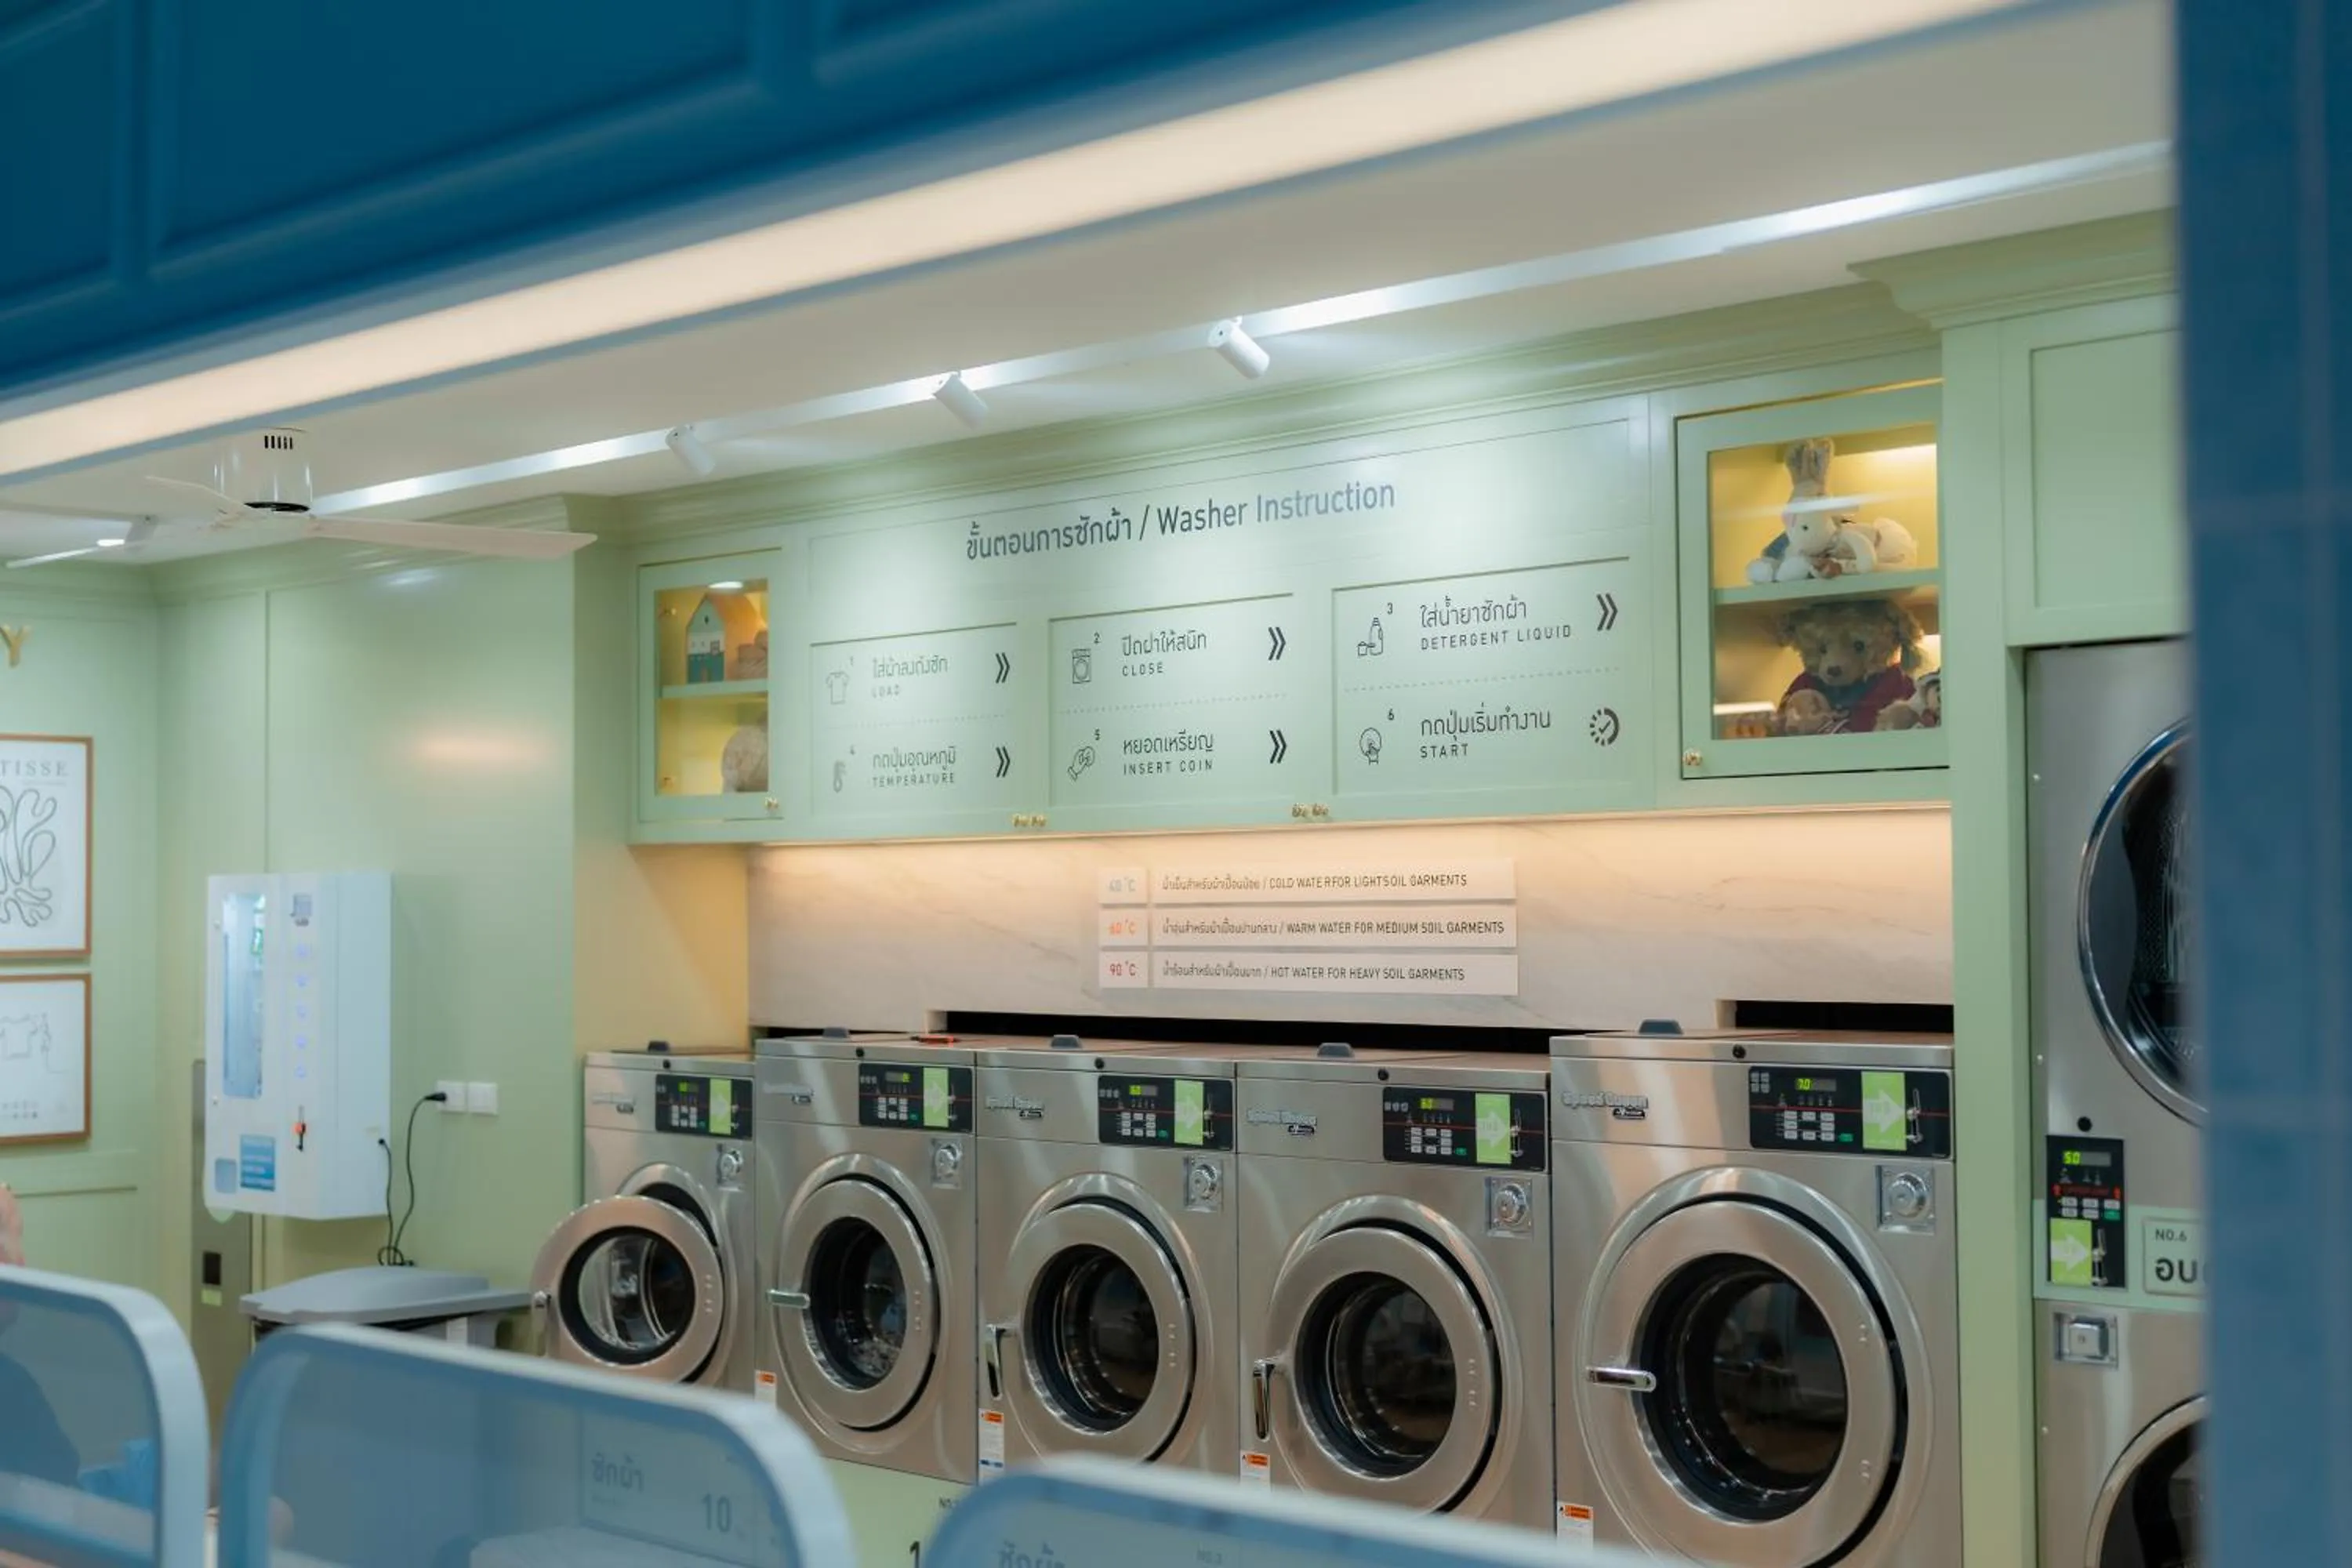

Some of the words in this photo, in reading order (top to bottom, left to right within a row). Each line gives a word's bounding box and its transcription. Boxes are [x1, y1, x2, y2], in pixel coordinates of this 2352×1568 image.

[967, 507, 1131, 560] ขั้นตอนการซักผ้า
[1139, 504, 1150, 541] /
[1157, 499, 1248, 535] Washer
[1256, 481, 1395, 523] Instruction
[1387, 602, 1393, 615] 3
[1420, 595, 1527, 628] ใส่น้ำยาซักผ้า
[1094, 632, 1100, 644] 2
[1121, 630, 1207, 657] ปิดฝาให้สนิท
[1421, 630, 1509, 651] DETERGENT
[1517, 624, 1572, 642] LIQUID
[1122, 662, 1164, 677] CLOSE
[1387, 709, 1395, 720] 6
[1421, 702, 1551, 742] กดปุ่มเริ่มทำงาน
[1094, 728, 1101, 740] 5
[1123, 729, 1214, 755] หยอดเหรียญ
[1420, 743, 1469, 759] START
[1123, 761, 1172, 775] INSERT
[1179, 760, 1214, 773] COIN
[873, 772, 956, 788] TEMPERATURE
[1269, 877, 1294, 889] COLD
[1297, 876, 1331, 888] WATER
[1333, 876, 1351, 887] FOR
[1354, 875, 1383, 888] LIGHT
[1383, 874, 1407, 887] SOIL
[1410, 874, 1468, 886] GARMENTS
[1287, 922, 1316, 934] WARM
[1319, 922, 1351, 934] WATER
[1354, 922, 1373, 934] FOR
[1376, 922, 1418, 935] MEDIUM
[1421, 922, 1443, 935] SOIL
[1446, 922, 1504, 935] GARMENTS
[1109, 964, 1122, 976] 90
[1271, 967, 1290, 978] HOT
[1292, 967, 1324, 978] WATER
[1327, 967, 1346, 978] FOR
[1349, 967, 1380, 979] HEAVY
[1382, 967, 1405, 979] SOIL
[1408, 968, 1465, 980] GARMENTS
[702, 1494, 731, 1533] 10
